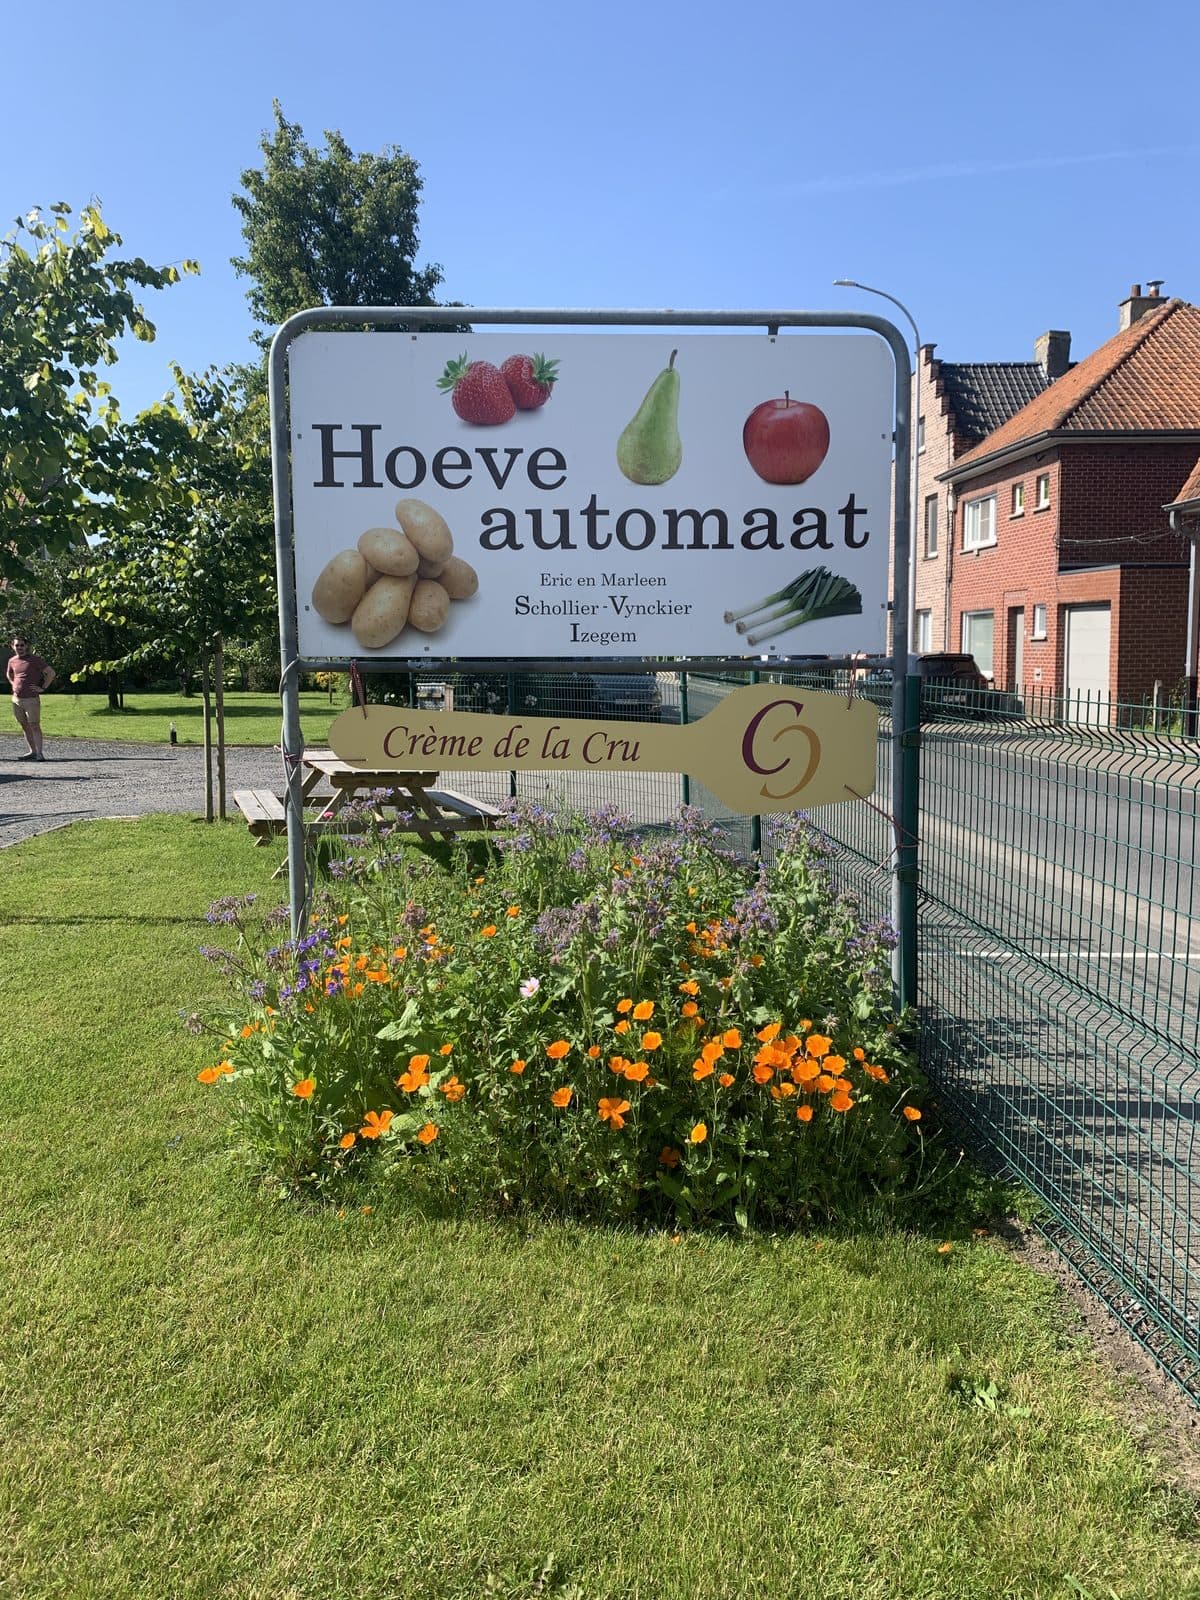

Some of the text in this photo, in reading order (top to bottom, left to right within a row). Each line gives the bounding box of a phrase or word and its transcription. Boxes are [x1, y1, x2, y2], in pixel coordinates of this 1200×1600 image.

[312, 424, 567, 490] Hoeve
[480, 493, 869, 551] automaat
[540, 572, 667, 587] Eric en Marleen
[570, 622, 637, 645] Izegem
[383, 725, 641, 764] Crème de la Cru
